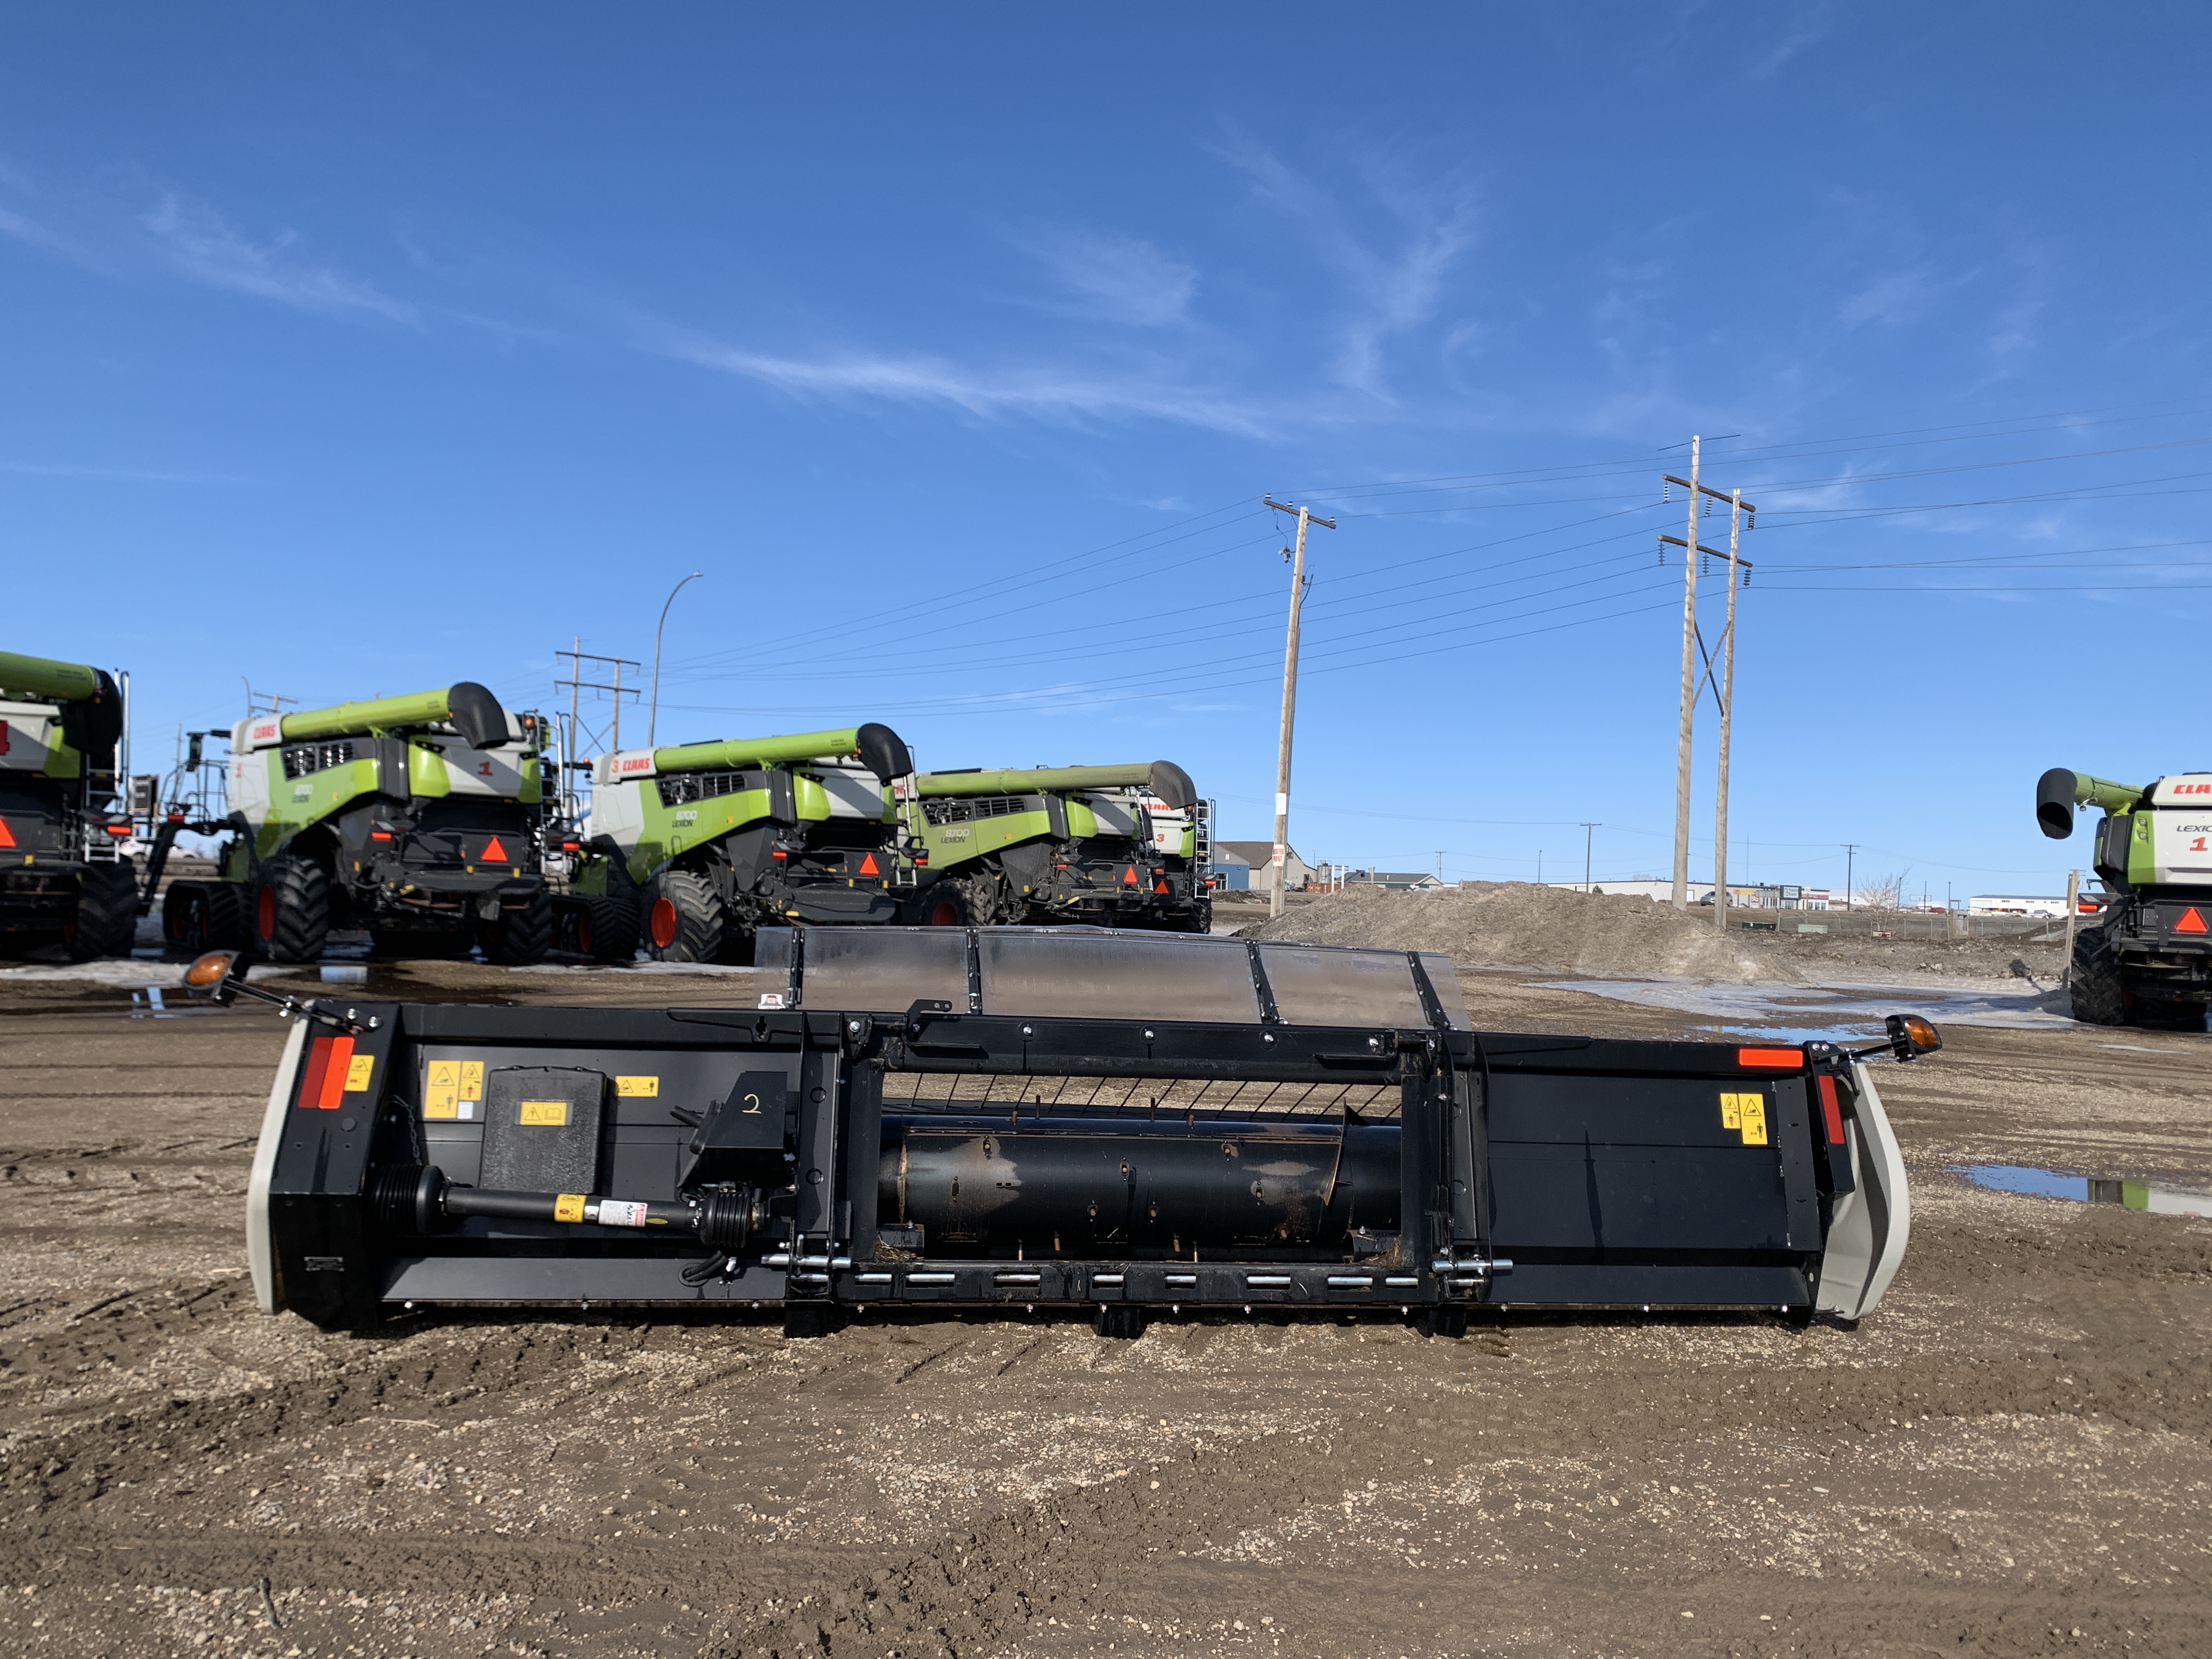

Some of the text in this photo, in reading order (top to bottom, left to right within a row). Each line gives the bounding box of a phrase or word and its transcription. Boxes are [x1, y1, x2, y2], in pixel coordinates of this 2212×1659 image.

[478, 761, 493, 777] 1
[623, 758, 650, 771] CLAAS
[2173, 784, 2212, 794] CLA
[945, 829, 970, 837] 8700
[1156, 833, 1165, 842] 3
[2190, 837, 2208, 851] 1
[742, 1093, 762, 1114] 2
